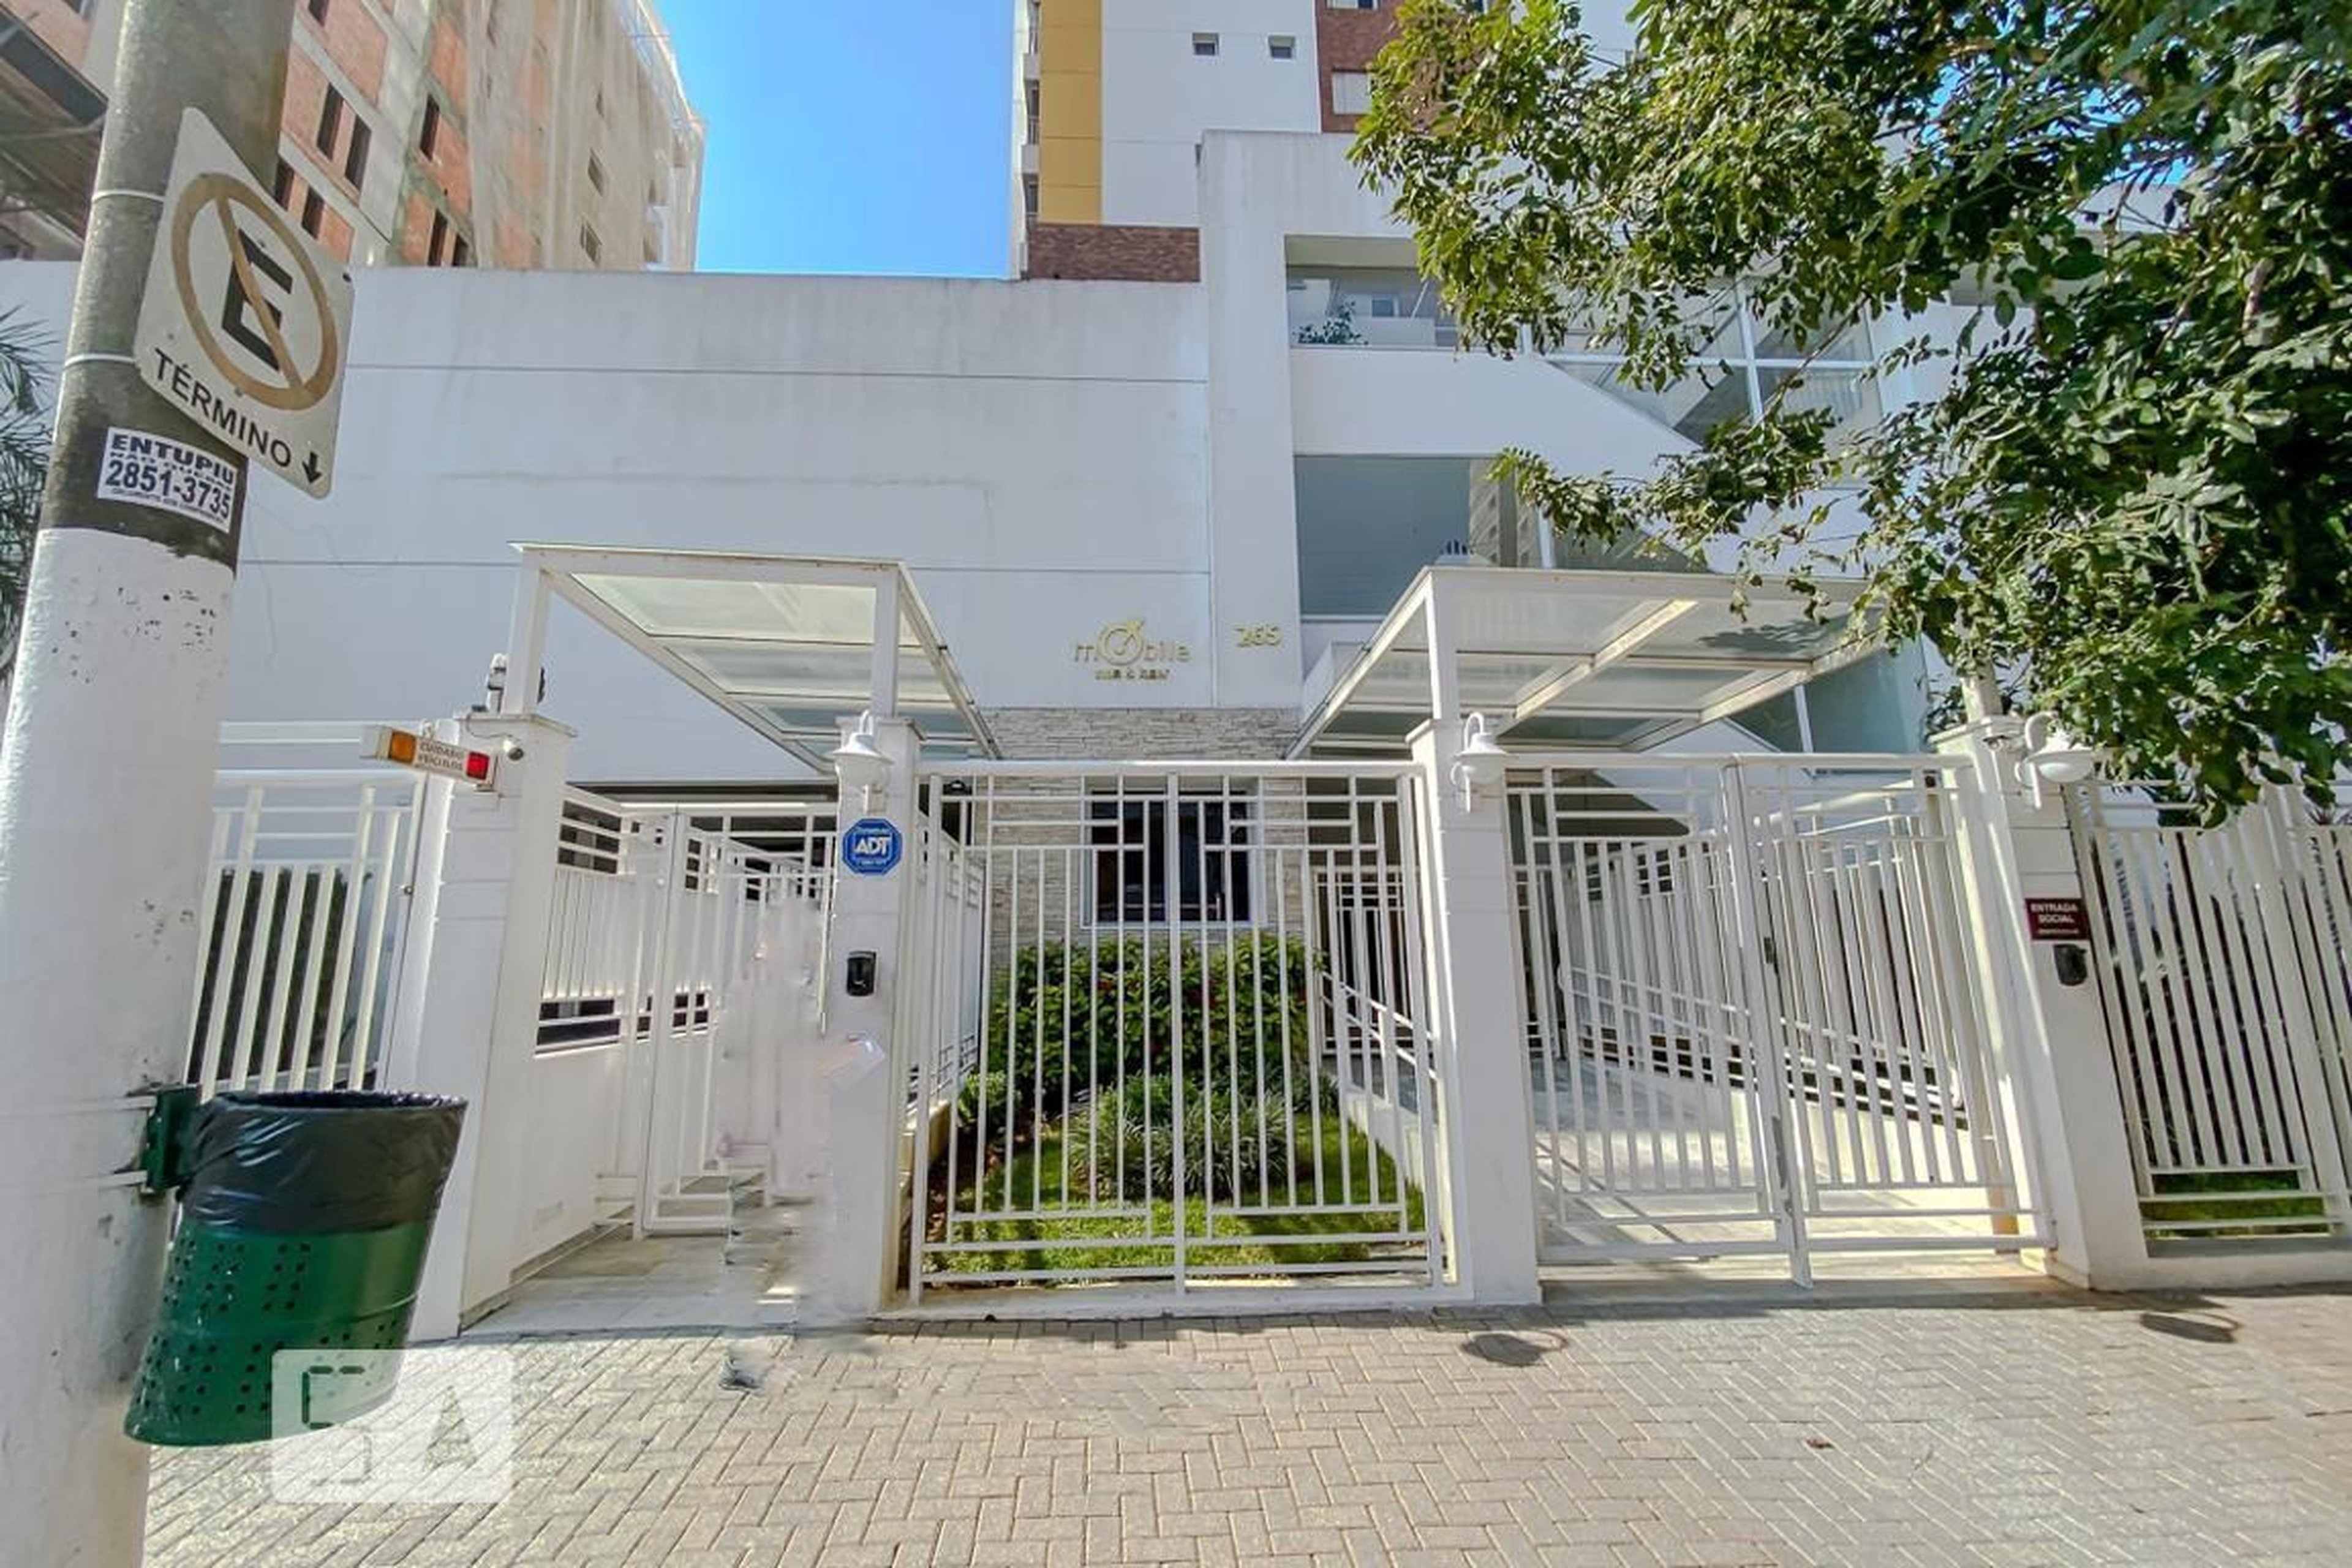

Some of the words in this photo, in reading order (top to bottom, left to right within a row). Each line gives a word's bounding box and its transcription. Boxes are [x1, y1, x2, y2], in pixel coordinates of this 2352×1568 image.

[155, 347, 292, 467] TÉRMINO
[111, 434, 233, 485] ENTUPIU
[105, 460, 230, 519] 2851-3735
[854, 837, 892, 856] ADT
[2030, 903, 2078, 913] ENTRADA
[2038, 913, 2075, 924] SOCIAL
